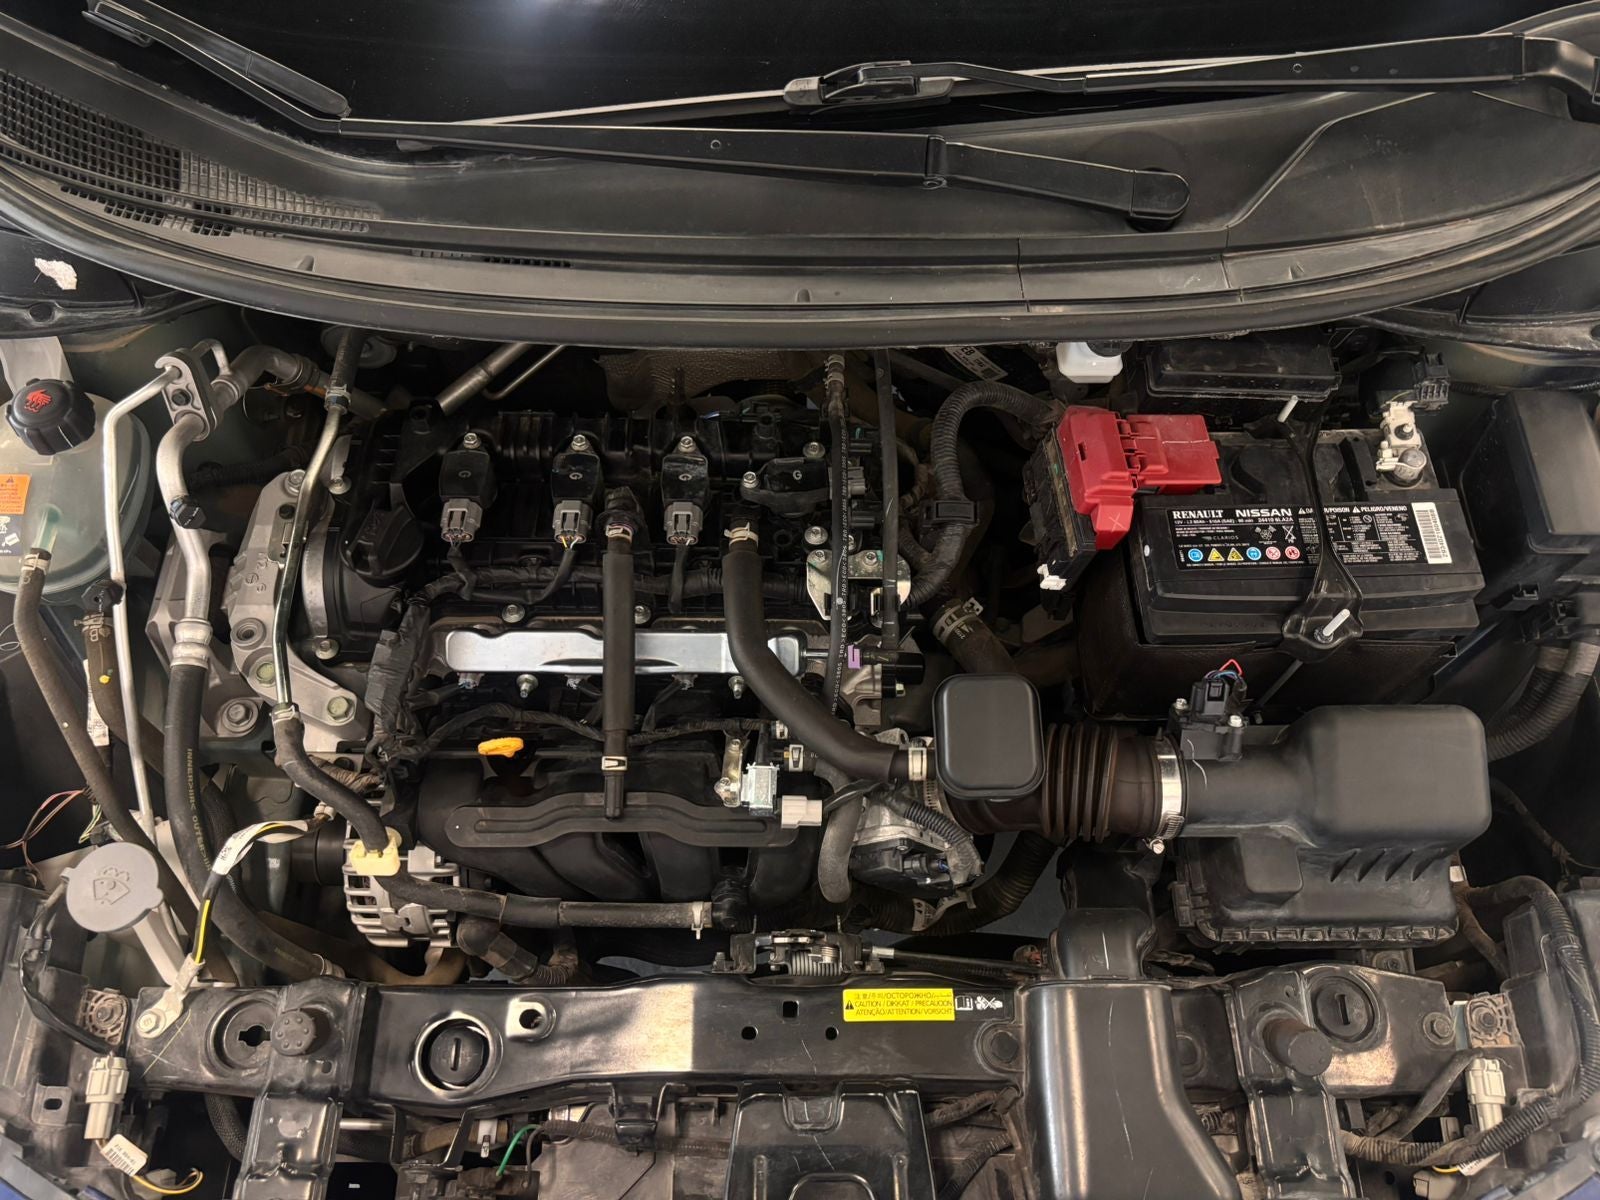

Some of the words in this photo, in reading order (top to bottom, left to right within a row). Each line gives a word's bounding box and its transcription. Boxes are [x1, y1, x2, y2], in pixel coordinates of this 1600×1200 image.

[1172, 509, 1224, 519] RENAULT
[1235, 508, 1293, 518] NISSAN
[855, 1000, 882, 1008] CAUTION
